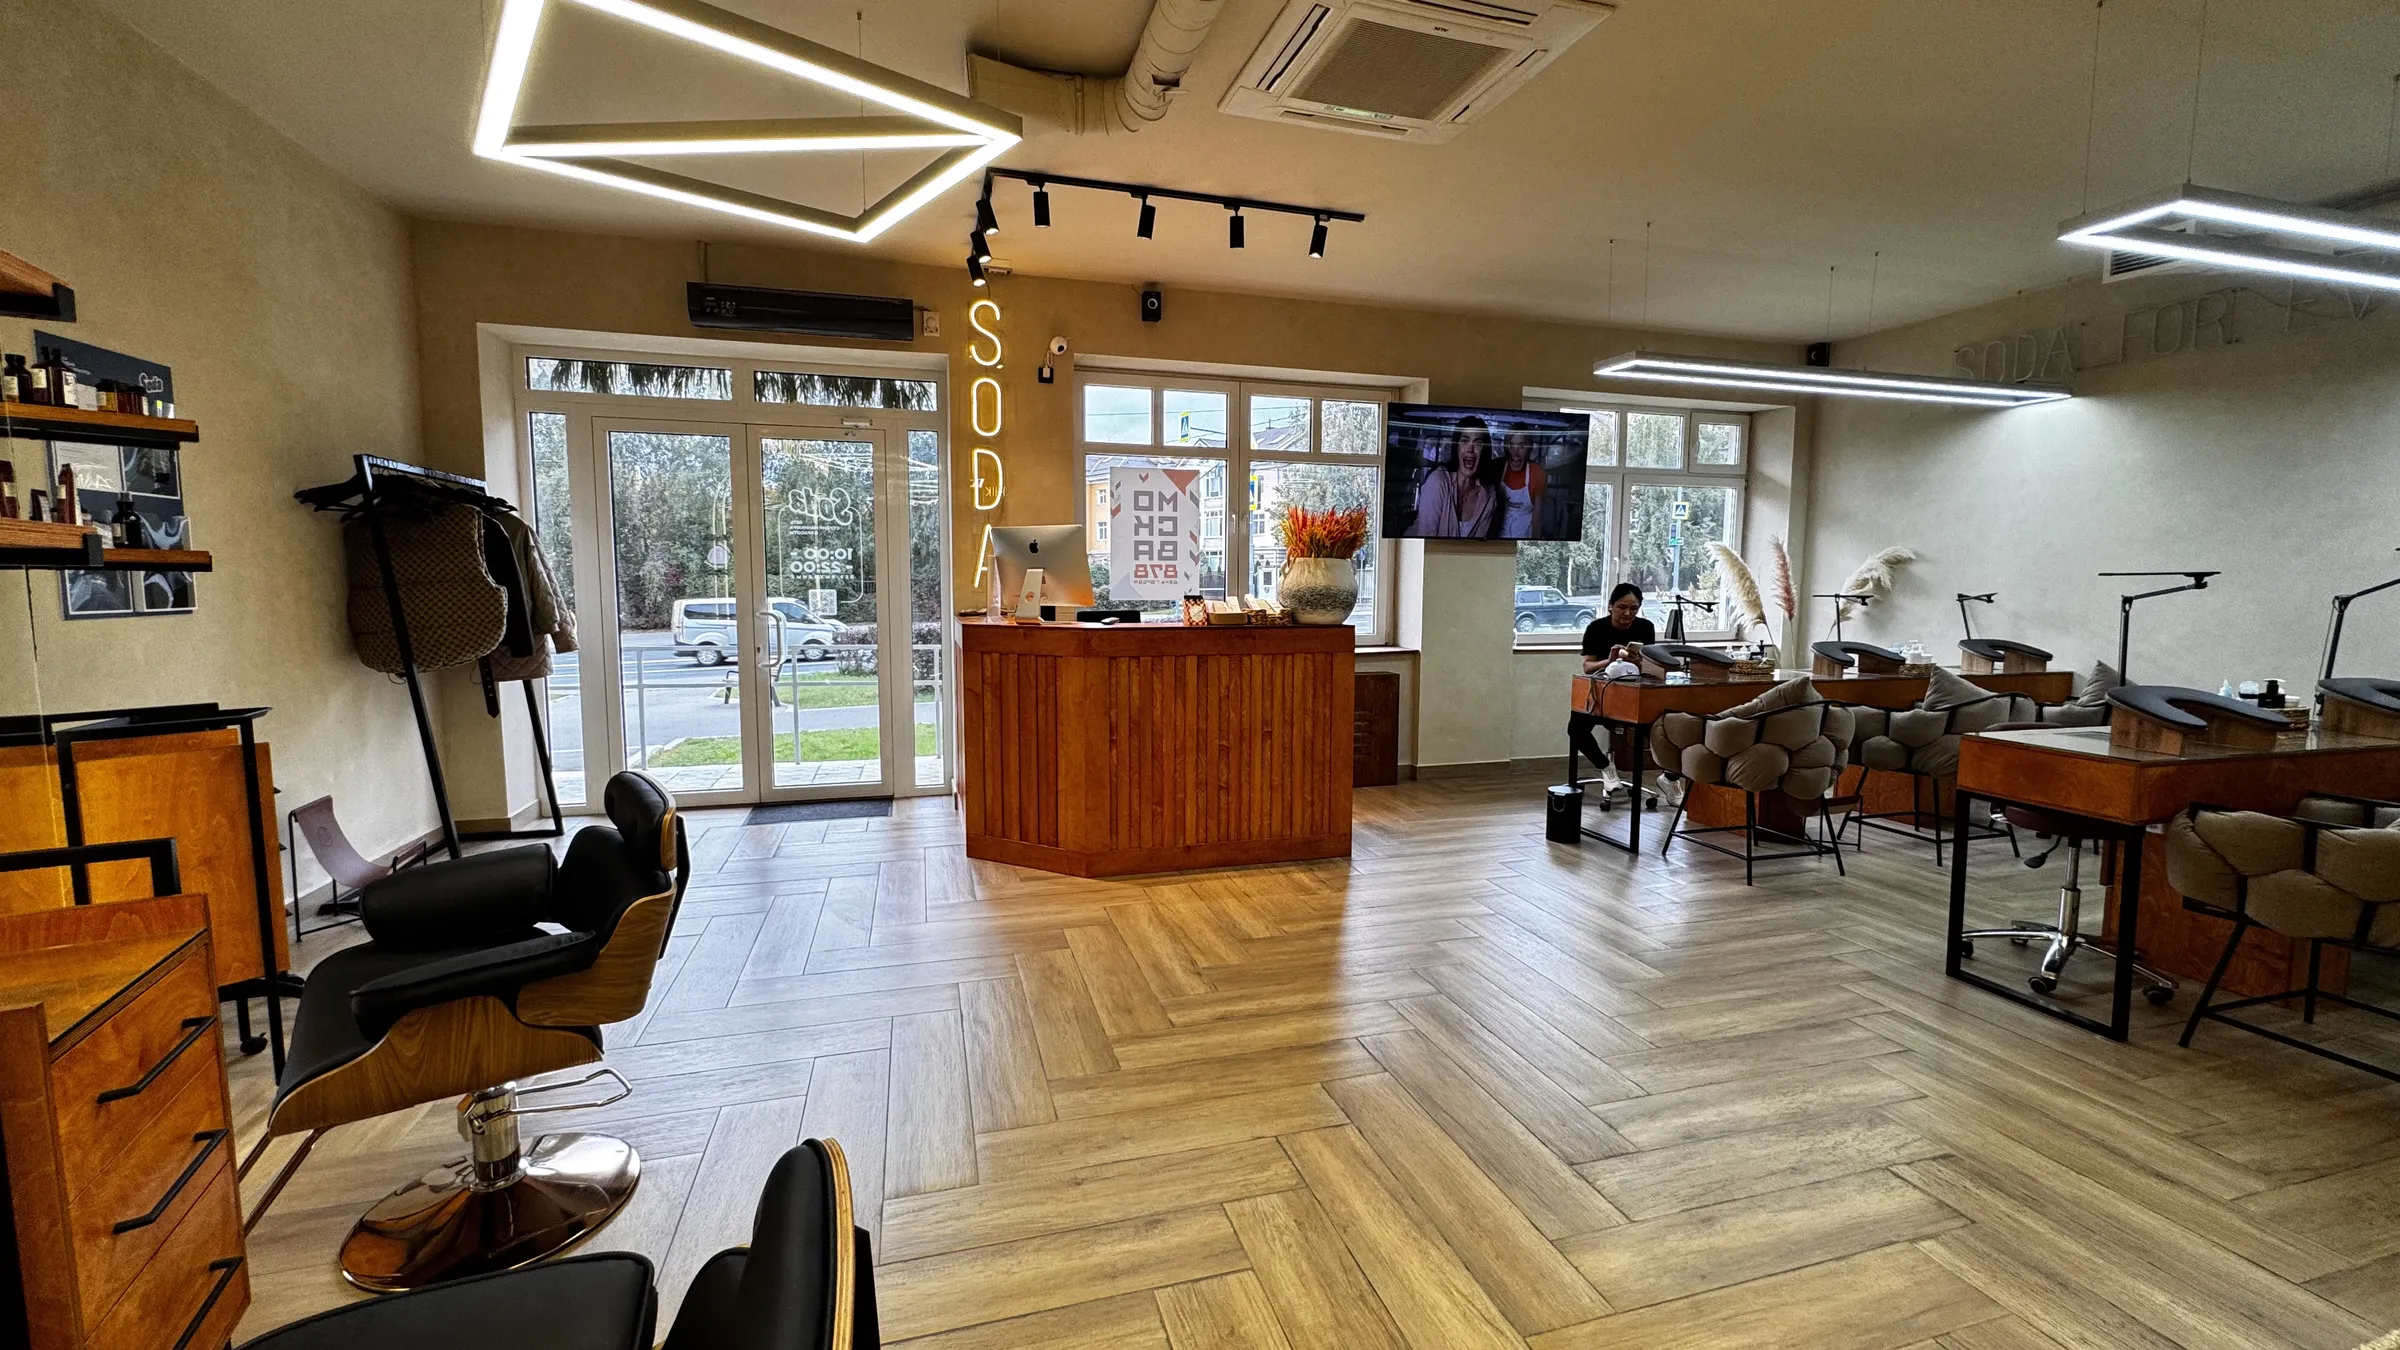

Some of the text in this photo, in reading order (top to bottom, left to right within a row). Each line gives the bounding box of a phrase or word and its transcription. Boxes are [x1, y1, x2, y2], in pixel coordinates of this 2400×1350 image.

[1954, 325, 2074, 382] SODA
[2118, 292, 2226, 365] FOR
[970, 300, 1003, 588] SODA
